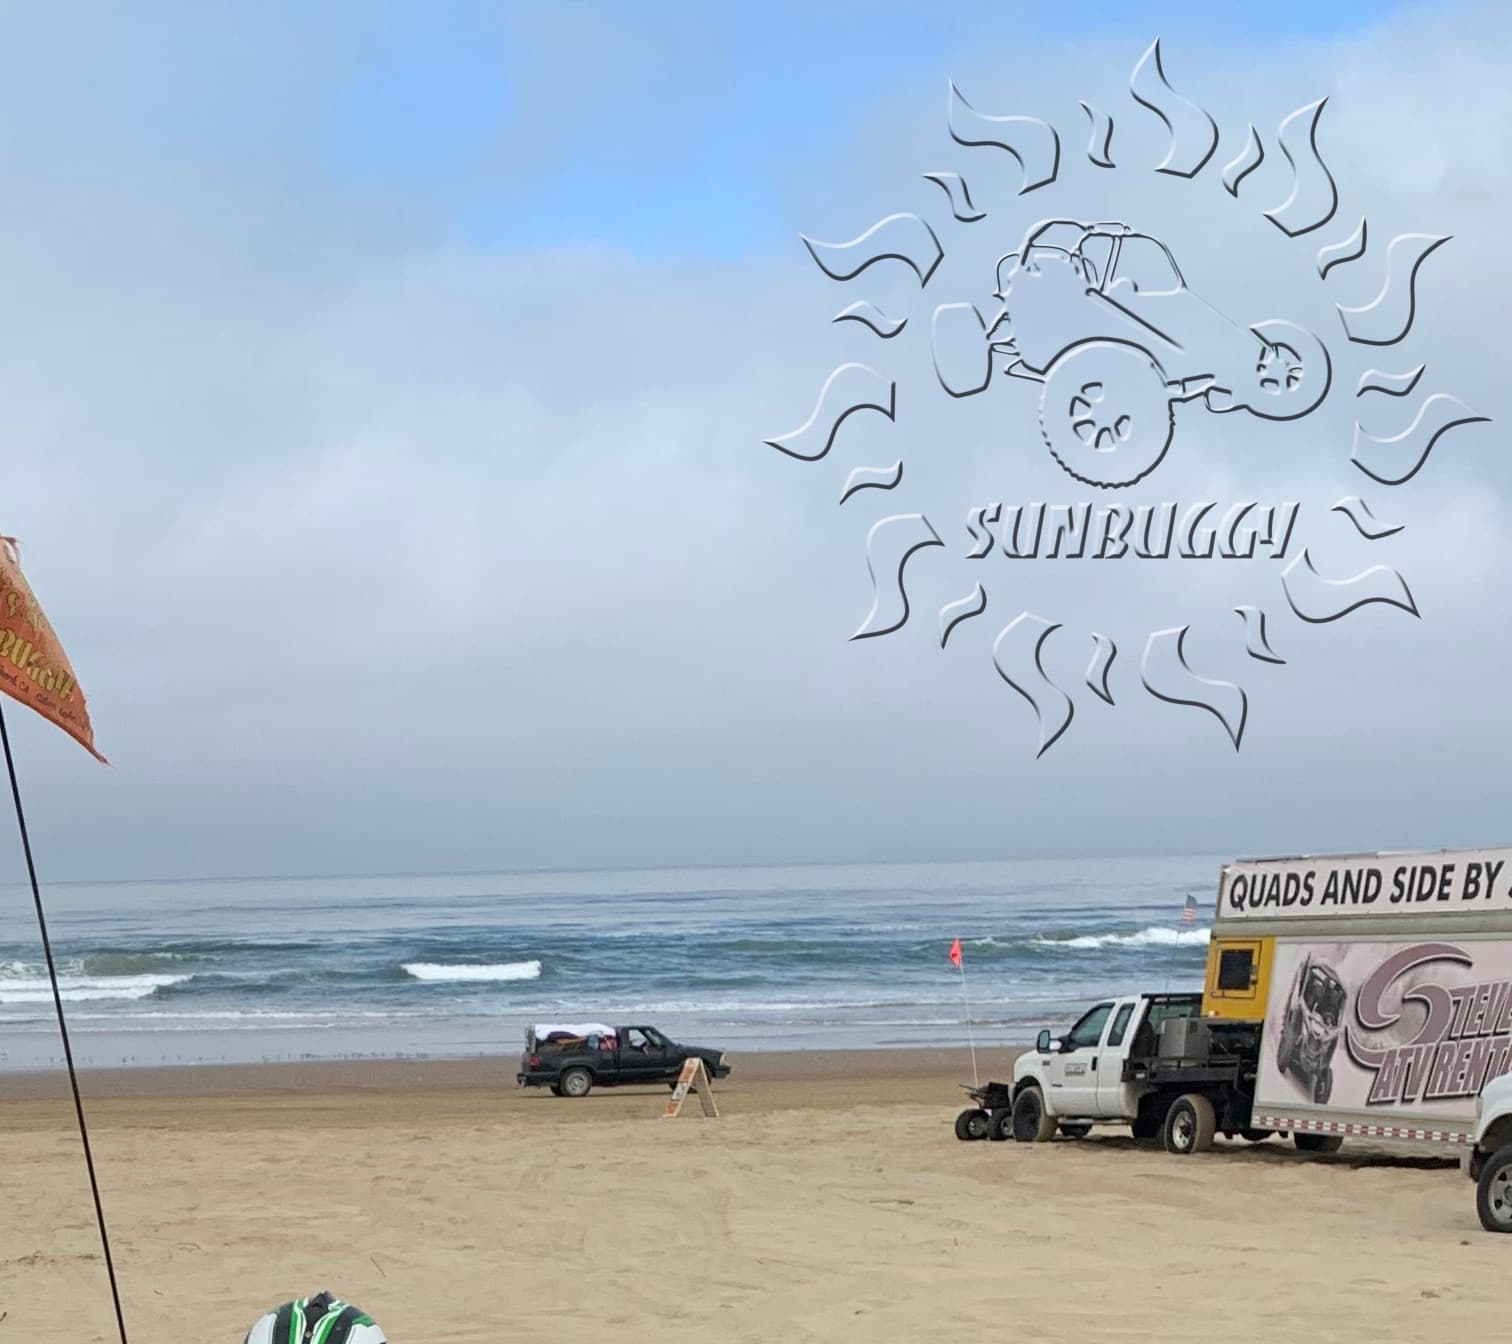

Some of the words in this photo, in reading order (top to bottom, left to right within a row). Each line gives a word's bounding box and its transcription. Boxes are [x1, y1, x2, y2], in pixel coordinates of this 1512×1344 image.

[1229, 870, 1316, 912] QUADS
[1320, 867, 1383, 906] AND
[1390, 863, 1456, 904] SIDE
[1462, 860, 1505, 900] BY
[1367, 1043, 1445, 1106] ATV
